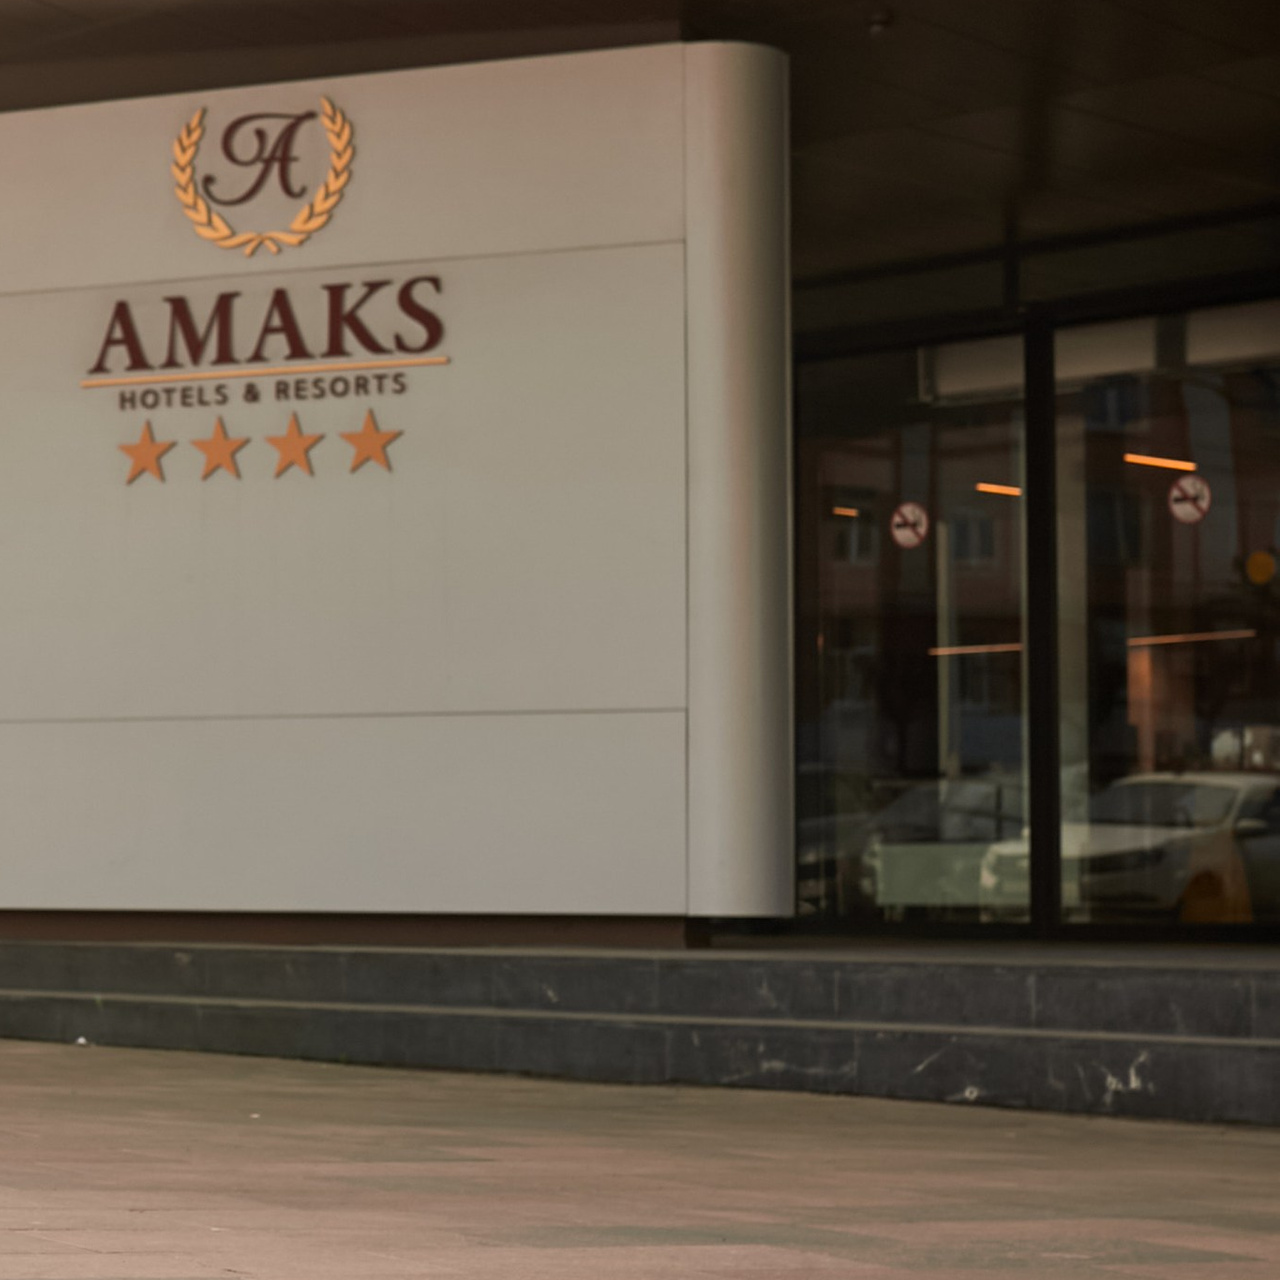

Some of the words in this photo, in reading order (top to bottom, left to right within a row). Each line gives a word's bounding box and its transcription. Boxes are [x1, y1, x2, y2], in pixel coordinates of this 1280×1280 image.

[87, 275, 445, 376] AMAKS
[118, 383, 230, 411] HOTELS
[242, 382, 261, 404] &
[274, 372, 408, 402] RESORTS
